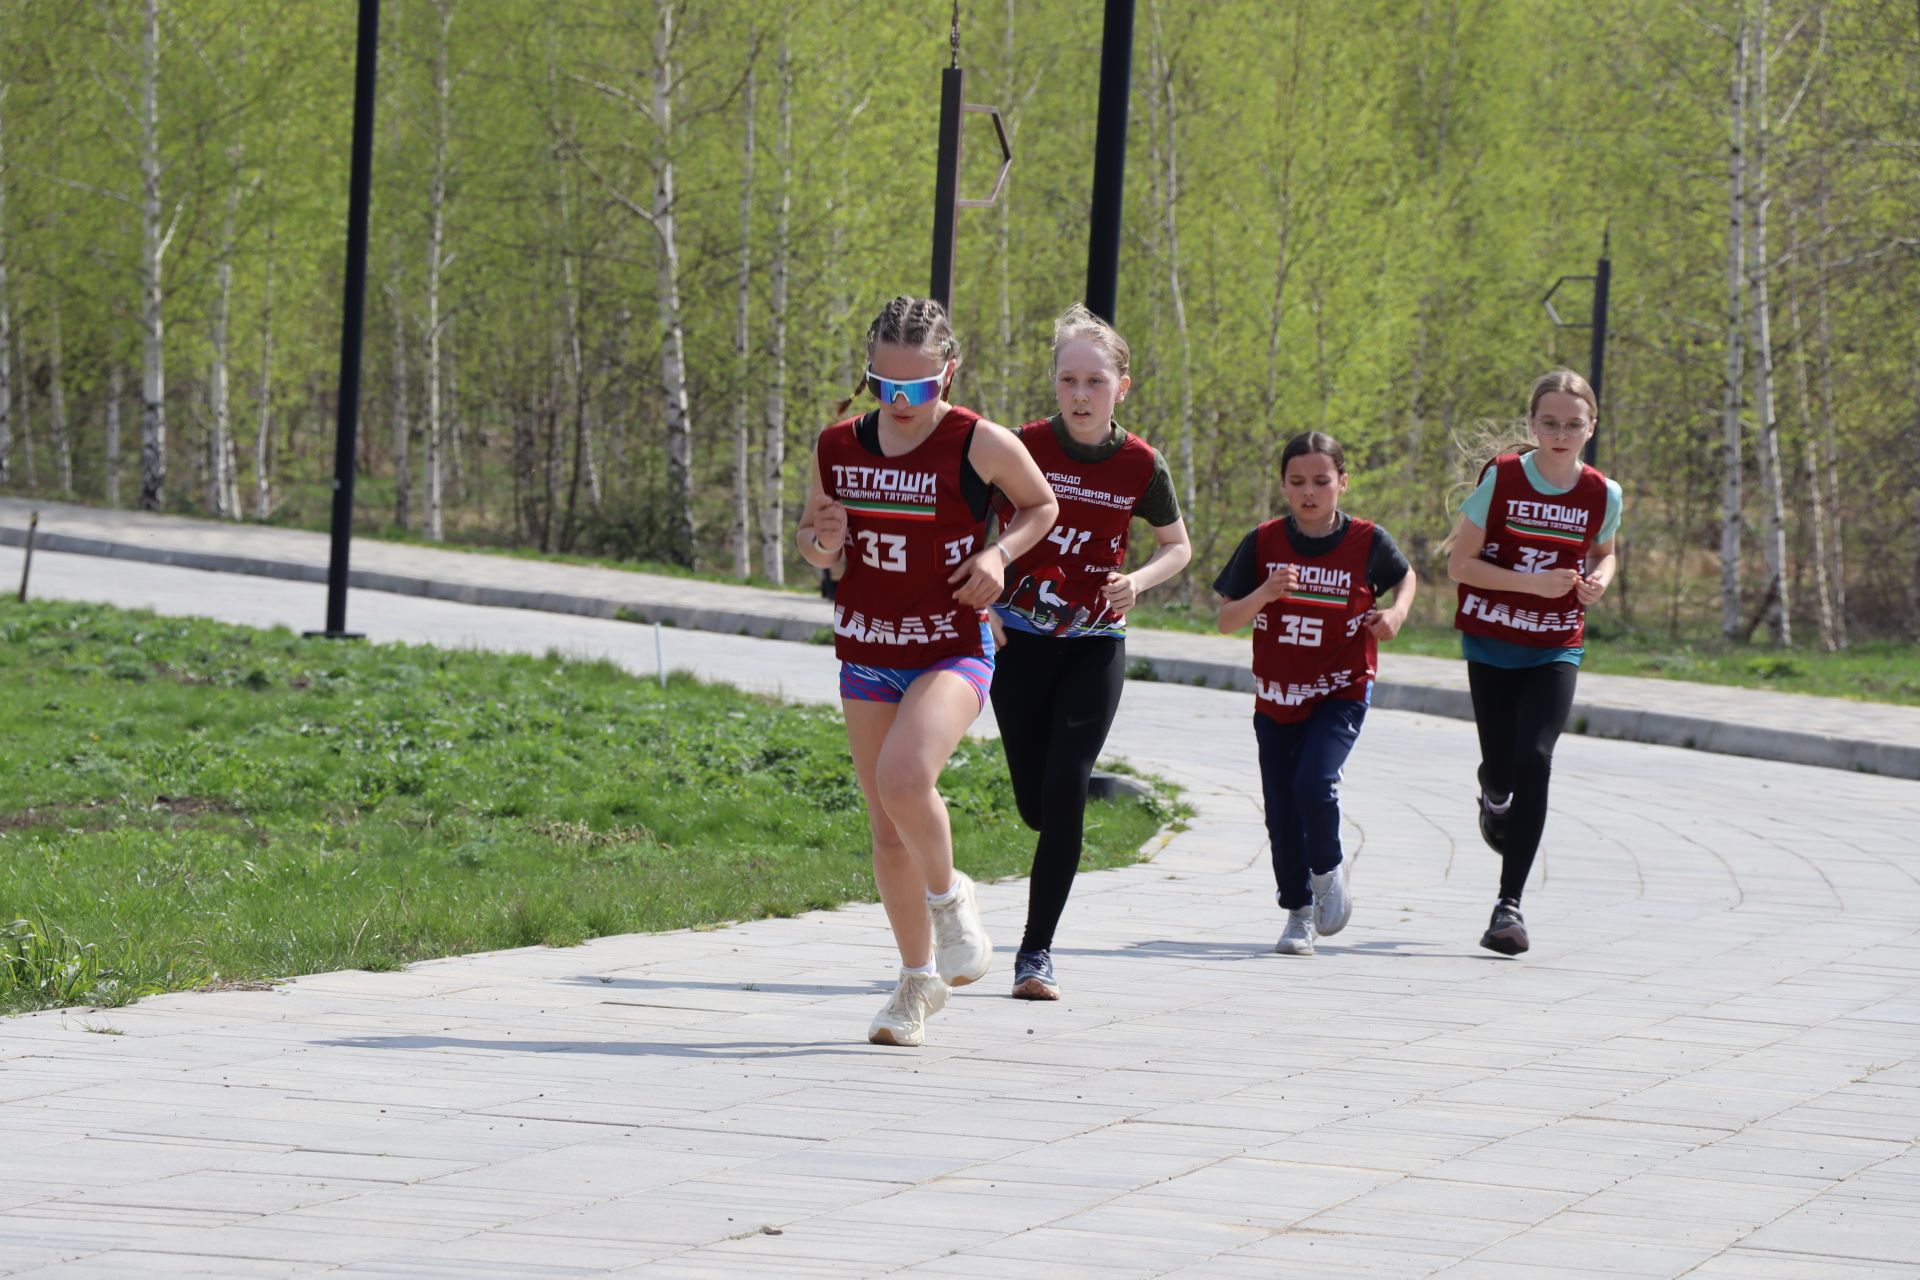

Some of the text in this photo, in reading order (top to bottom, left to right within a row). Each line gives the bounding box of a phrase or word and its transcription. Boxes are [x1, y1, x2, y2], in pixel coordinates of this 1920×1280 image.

[832, 464, 937, 495] ТЕТЮШИ
[1046, 472, 1081, 485] МБУДО
[884, 491, 937, 504] ТАТАРСТАН
[1506, 499, 1589, 526] ТЕТЮШИ
[857, 529, 908, 573] 33
[1513, 546, 1558, 574] 32
[834, 604, 960, 646] LAMAX
[1461, 593, 1580, 632] FLAMAX
[1278, 614, 1324, 647] 35
